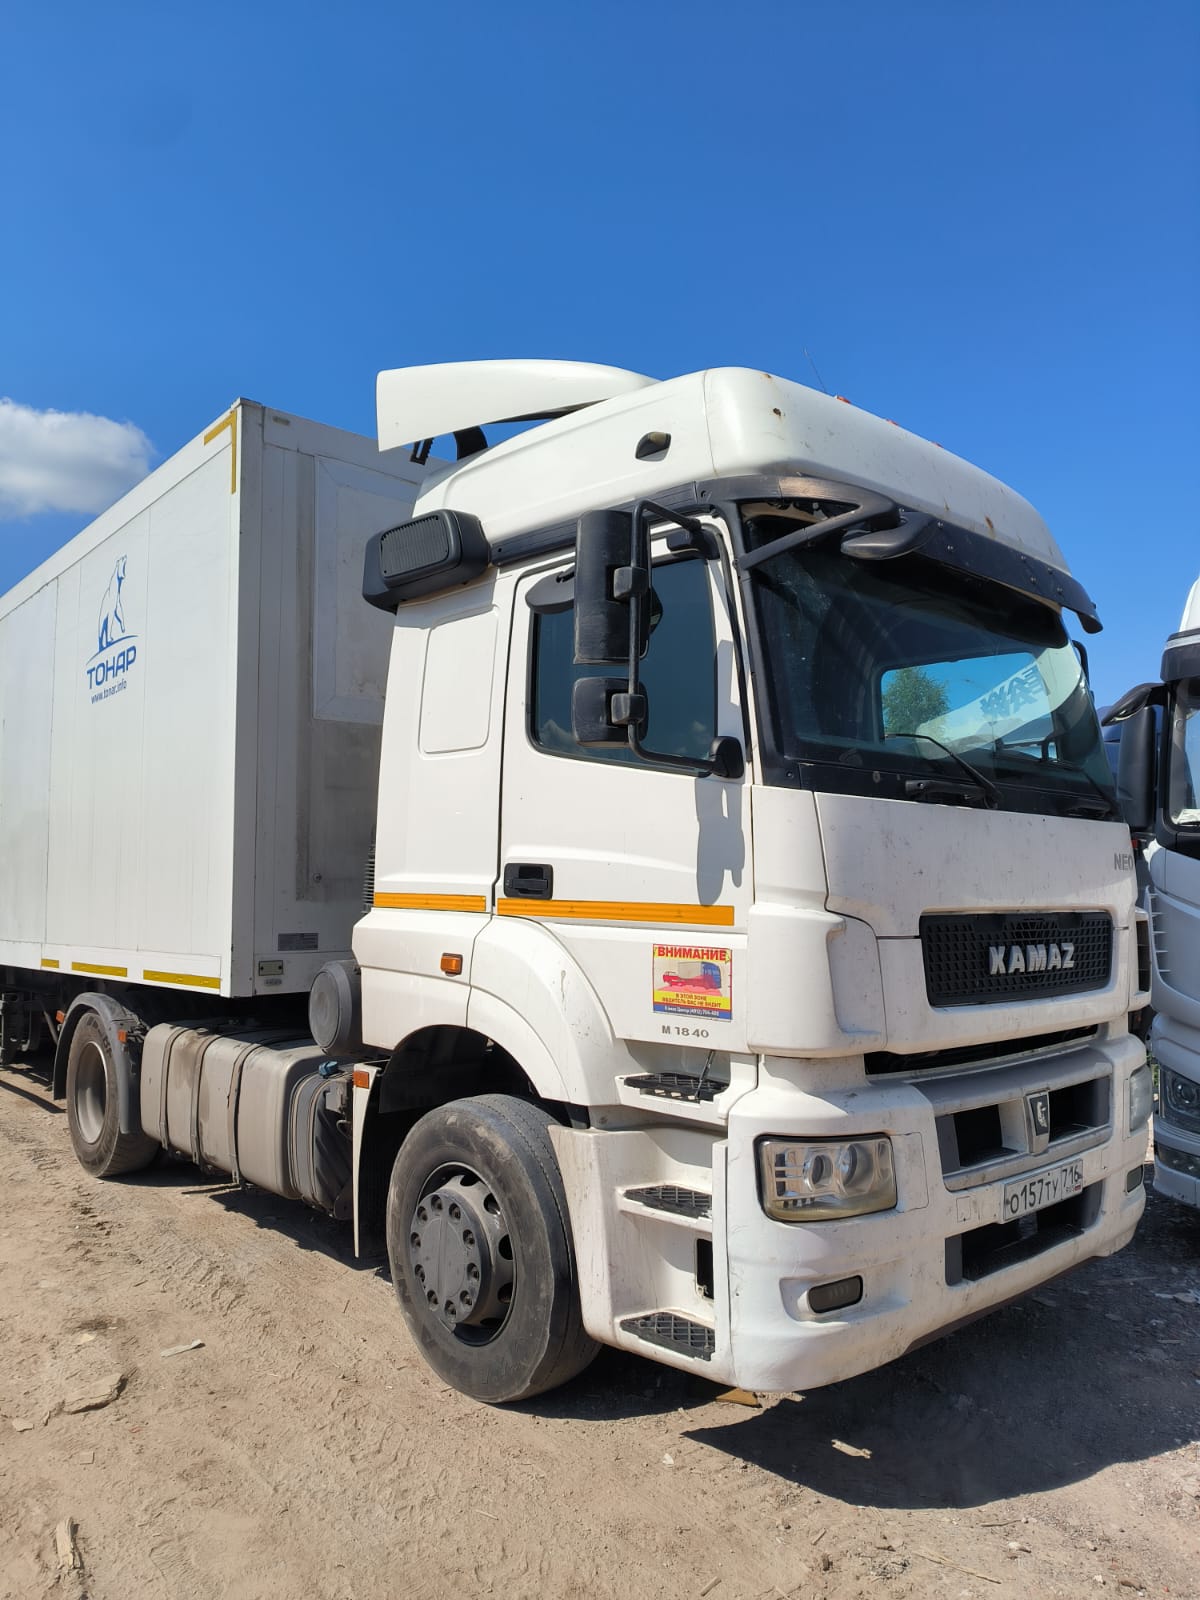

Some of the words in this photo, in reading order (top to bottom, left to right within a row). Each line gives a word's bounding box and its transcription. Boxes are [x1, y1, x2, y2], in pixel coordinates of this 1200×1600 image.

[87, 645, 137, 689] ТОНАР
[91, 678, 127, 704] www.tonar.info
[1113, 852, 1133, 871] NEO
[657, 946, 727, 961] ВНИМАНИЕ
[989, 942, 1075, 975] KAMAZ
[662, 1025, 671, 1035] M
[675, 1026, 709, 1038] 1840
